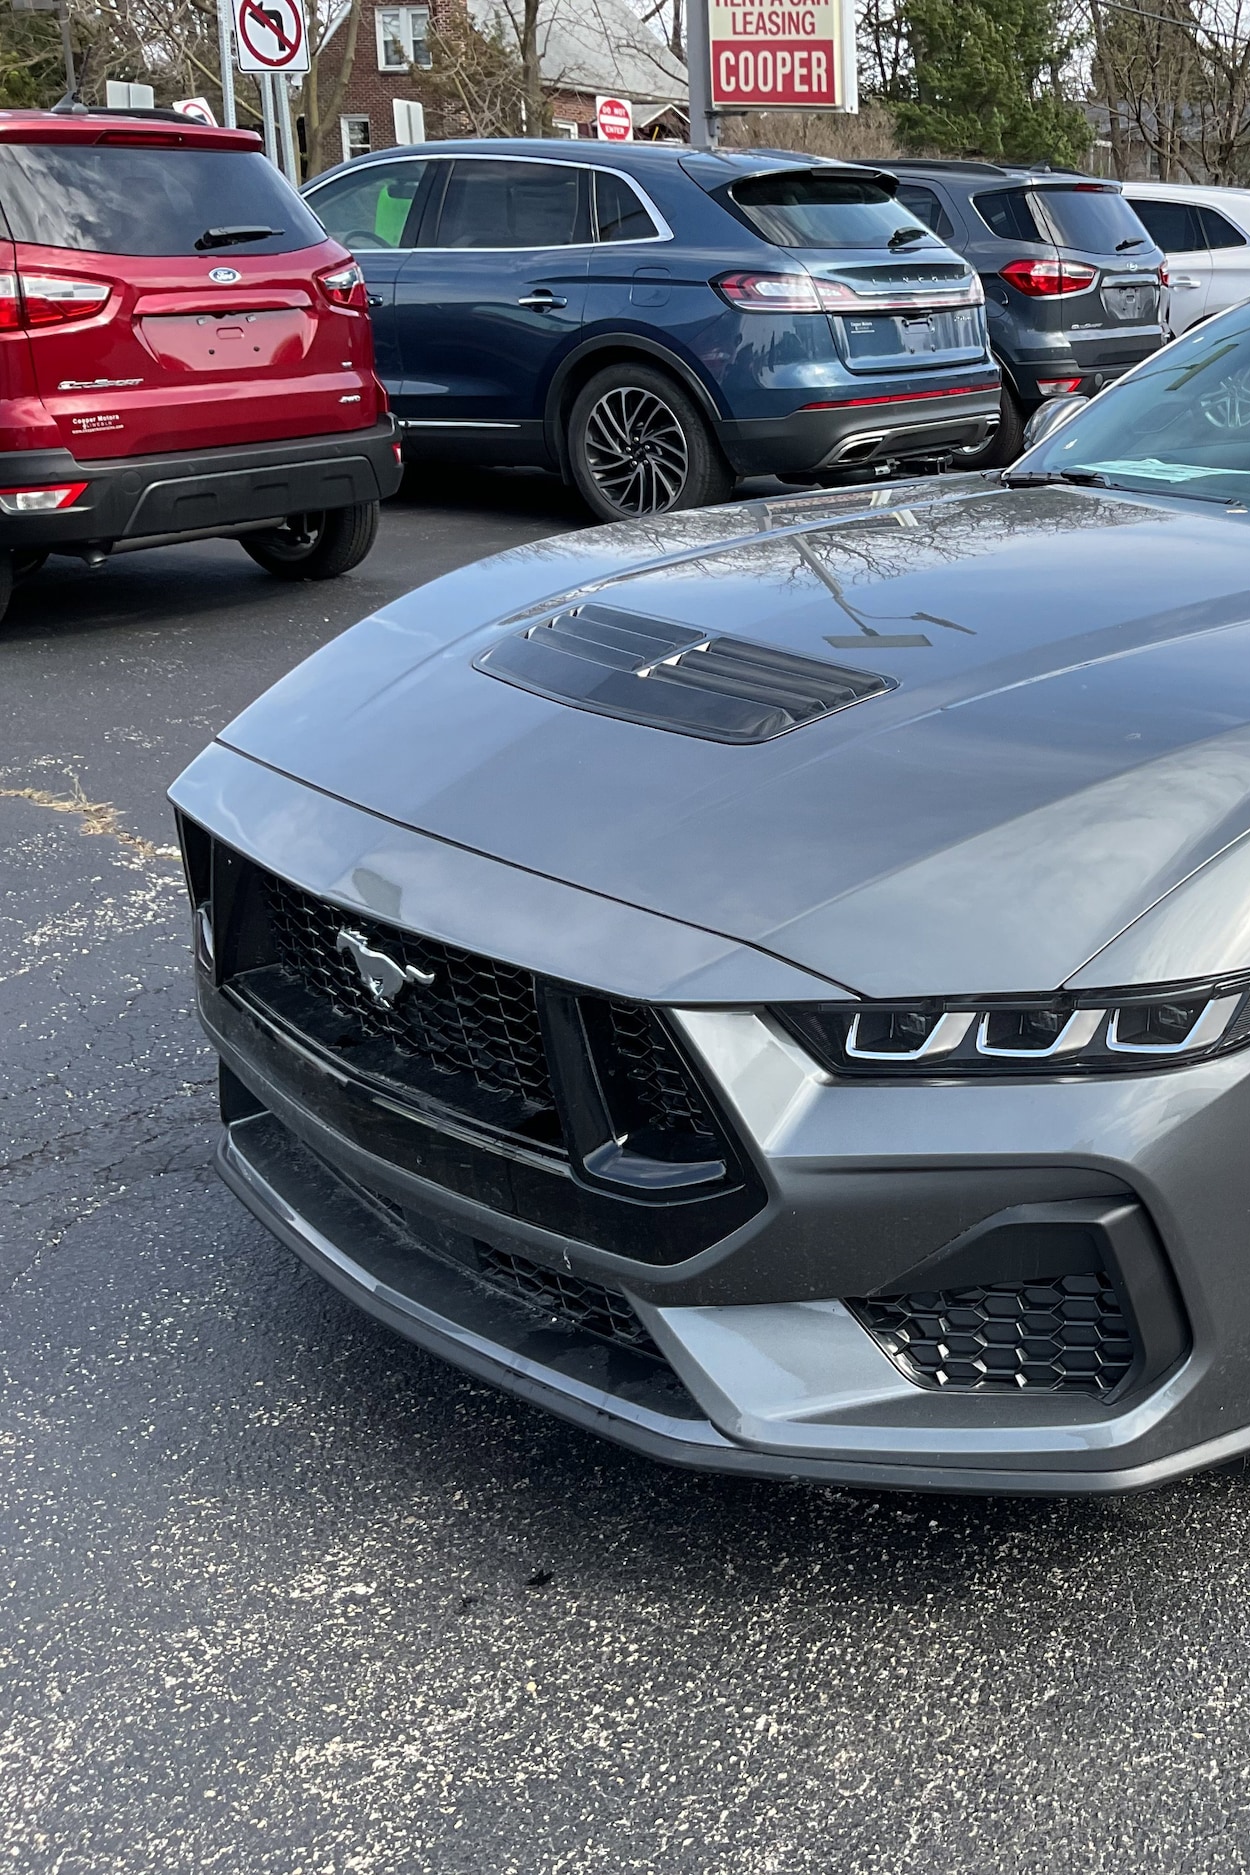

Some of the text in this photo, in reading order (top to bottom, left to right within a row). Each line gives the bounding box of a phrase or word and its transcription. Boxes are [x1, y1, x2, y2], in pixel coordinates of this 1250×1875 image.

[732, 11, 816, 35] LEASING
[719, 50, 828, 93] COOPER
[602, 106, 626, 117] DO NOT
[605, 126, 625, 135] ENTER
[97, 414, 119, 422] Motors
